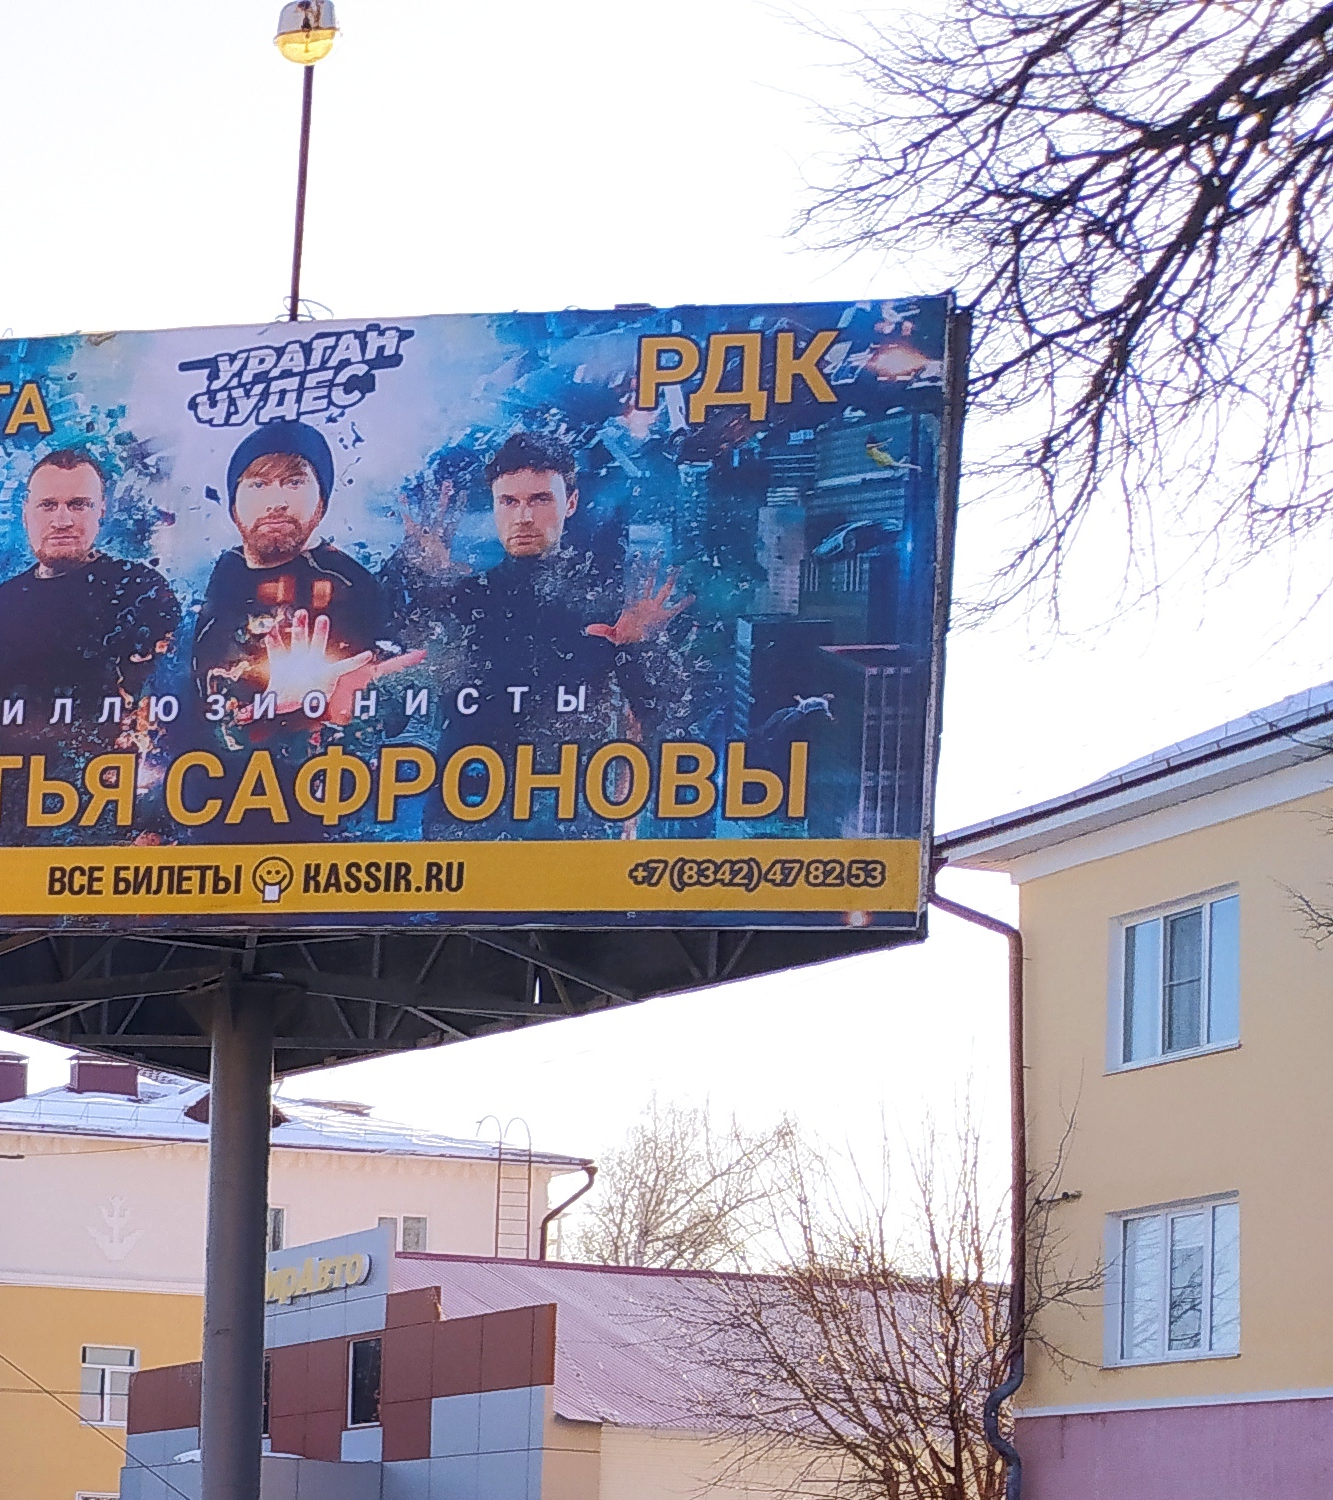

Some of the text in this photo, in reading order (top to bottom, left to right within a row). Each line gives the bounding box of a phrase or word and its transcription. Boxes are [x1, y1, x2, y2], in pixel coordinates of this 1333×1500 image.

[207, 328, 402, 392] УРАГАН
[636, 329, 841, 425] РДК
[194, 362, 371, 426] ЧУДЕС
[1, 685, 587, 726] ИЛЛЮЗИОНИСТЫ
[164, 740, 810, 827] САФРОНОВЫ
[47, 863, 243, 898] ВСЕ БИЛЕТЫ
[301, 860, 466, 894] KASSIR.RU
[630, 858, 885, 892] +7 (8342) 47 82 53
